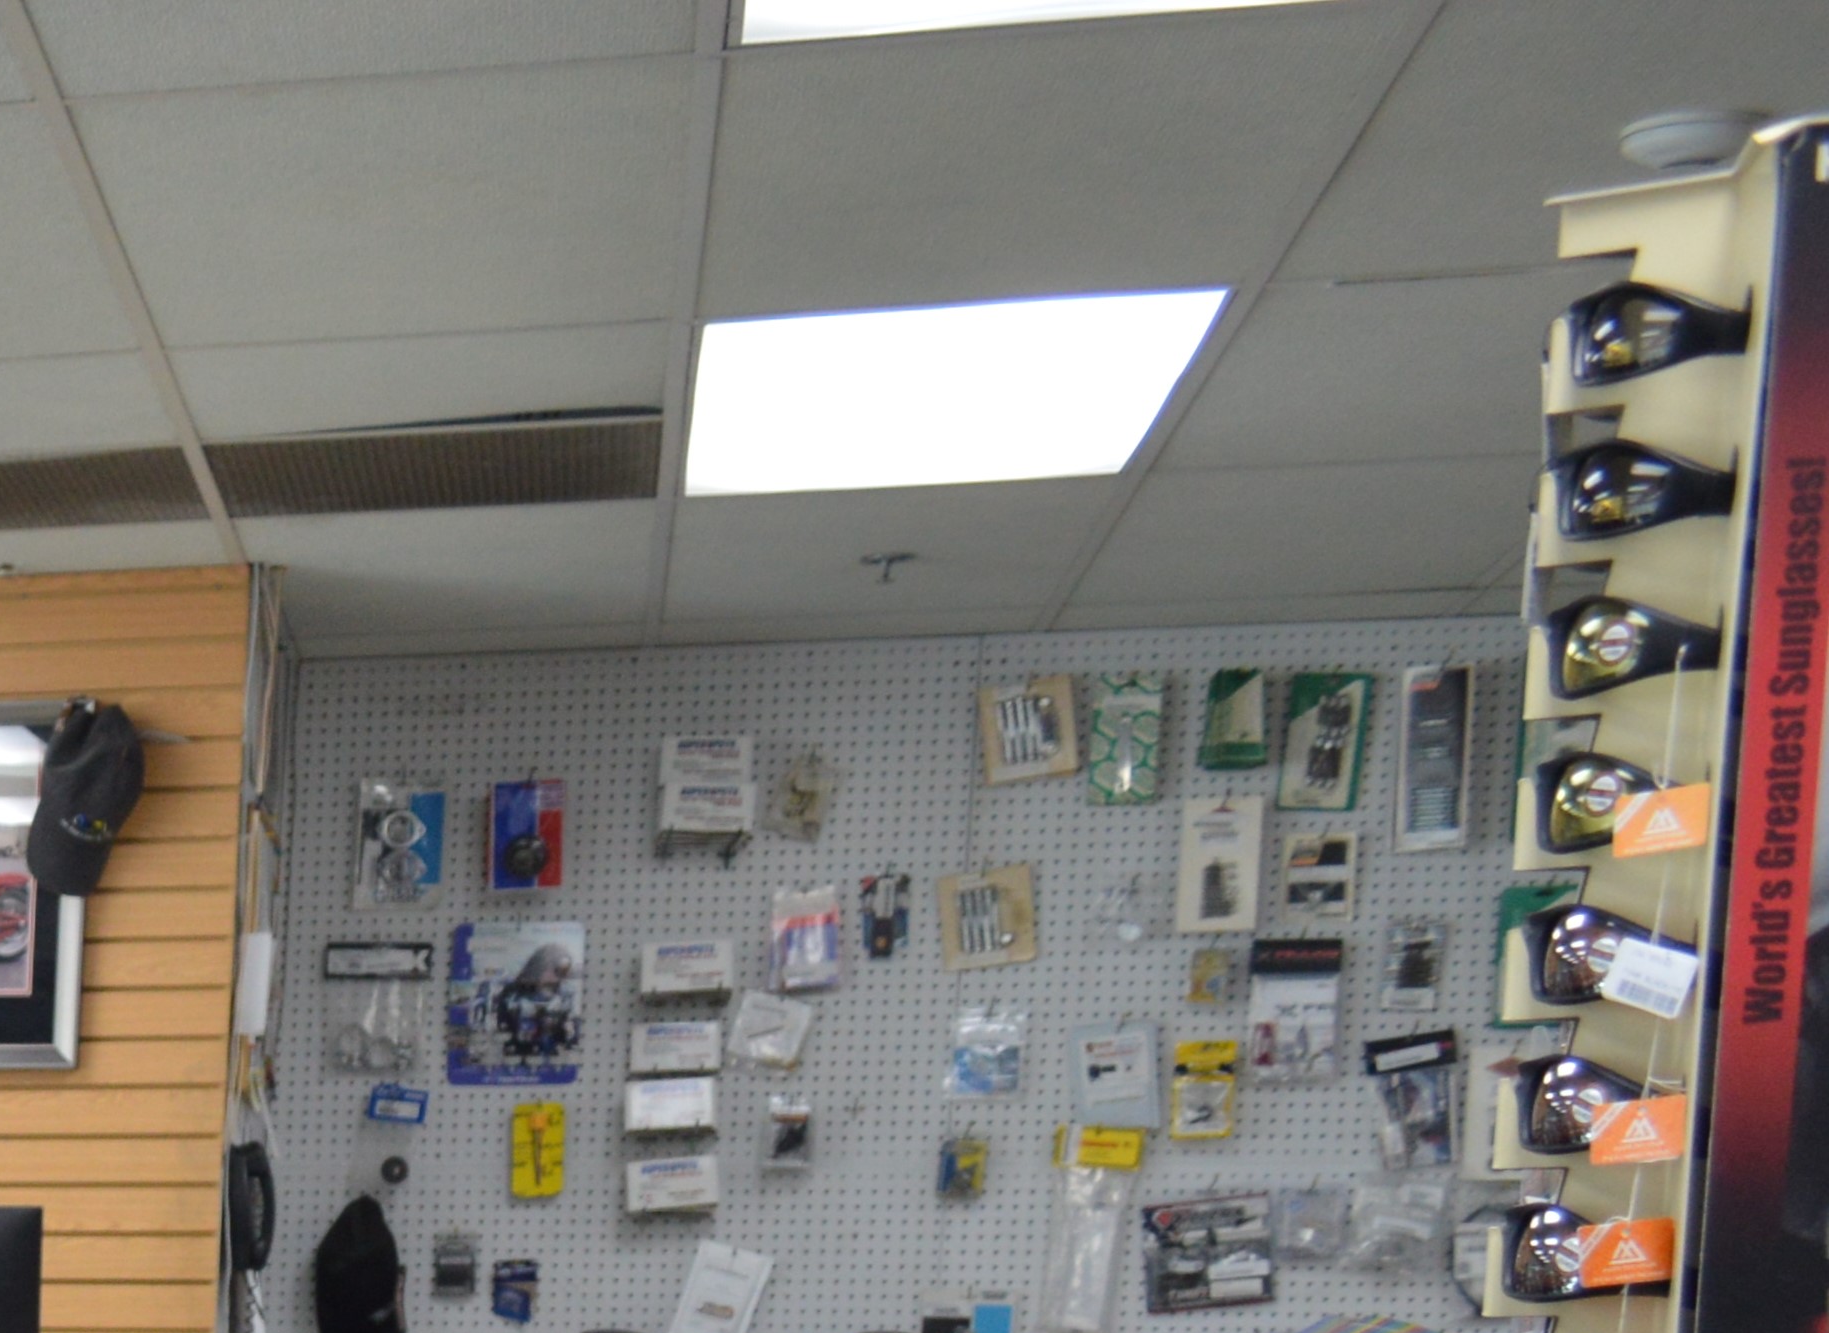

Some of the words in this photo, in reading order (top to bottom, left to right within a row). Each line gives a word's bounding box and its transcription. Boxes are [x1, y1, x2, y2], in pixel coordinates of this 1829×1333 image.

[1768, 457, 1827, 697] Sunglasses!
[1755, 705, 1806, 868] Greatest
[1742, 880, 1794, 1023] World's
